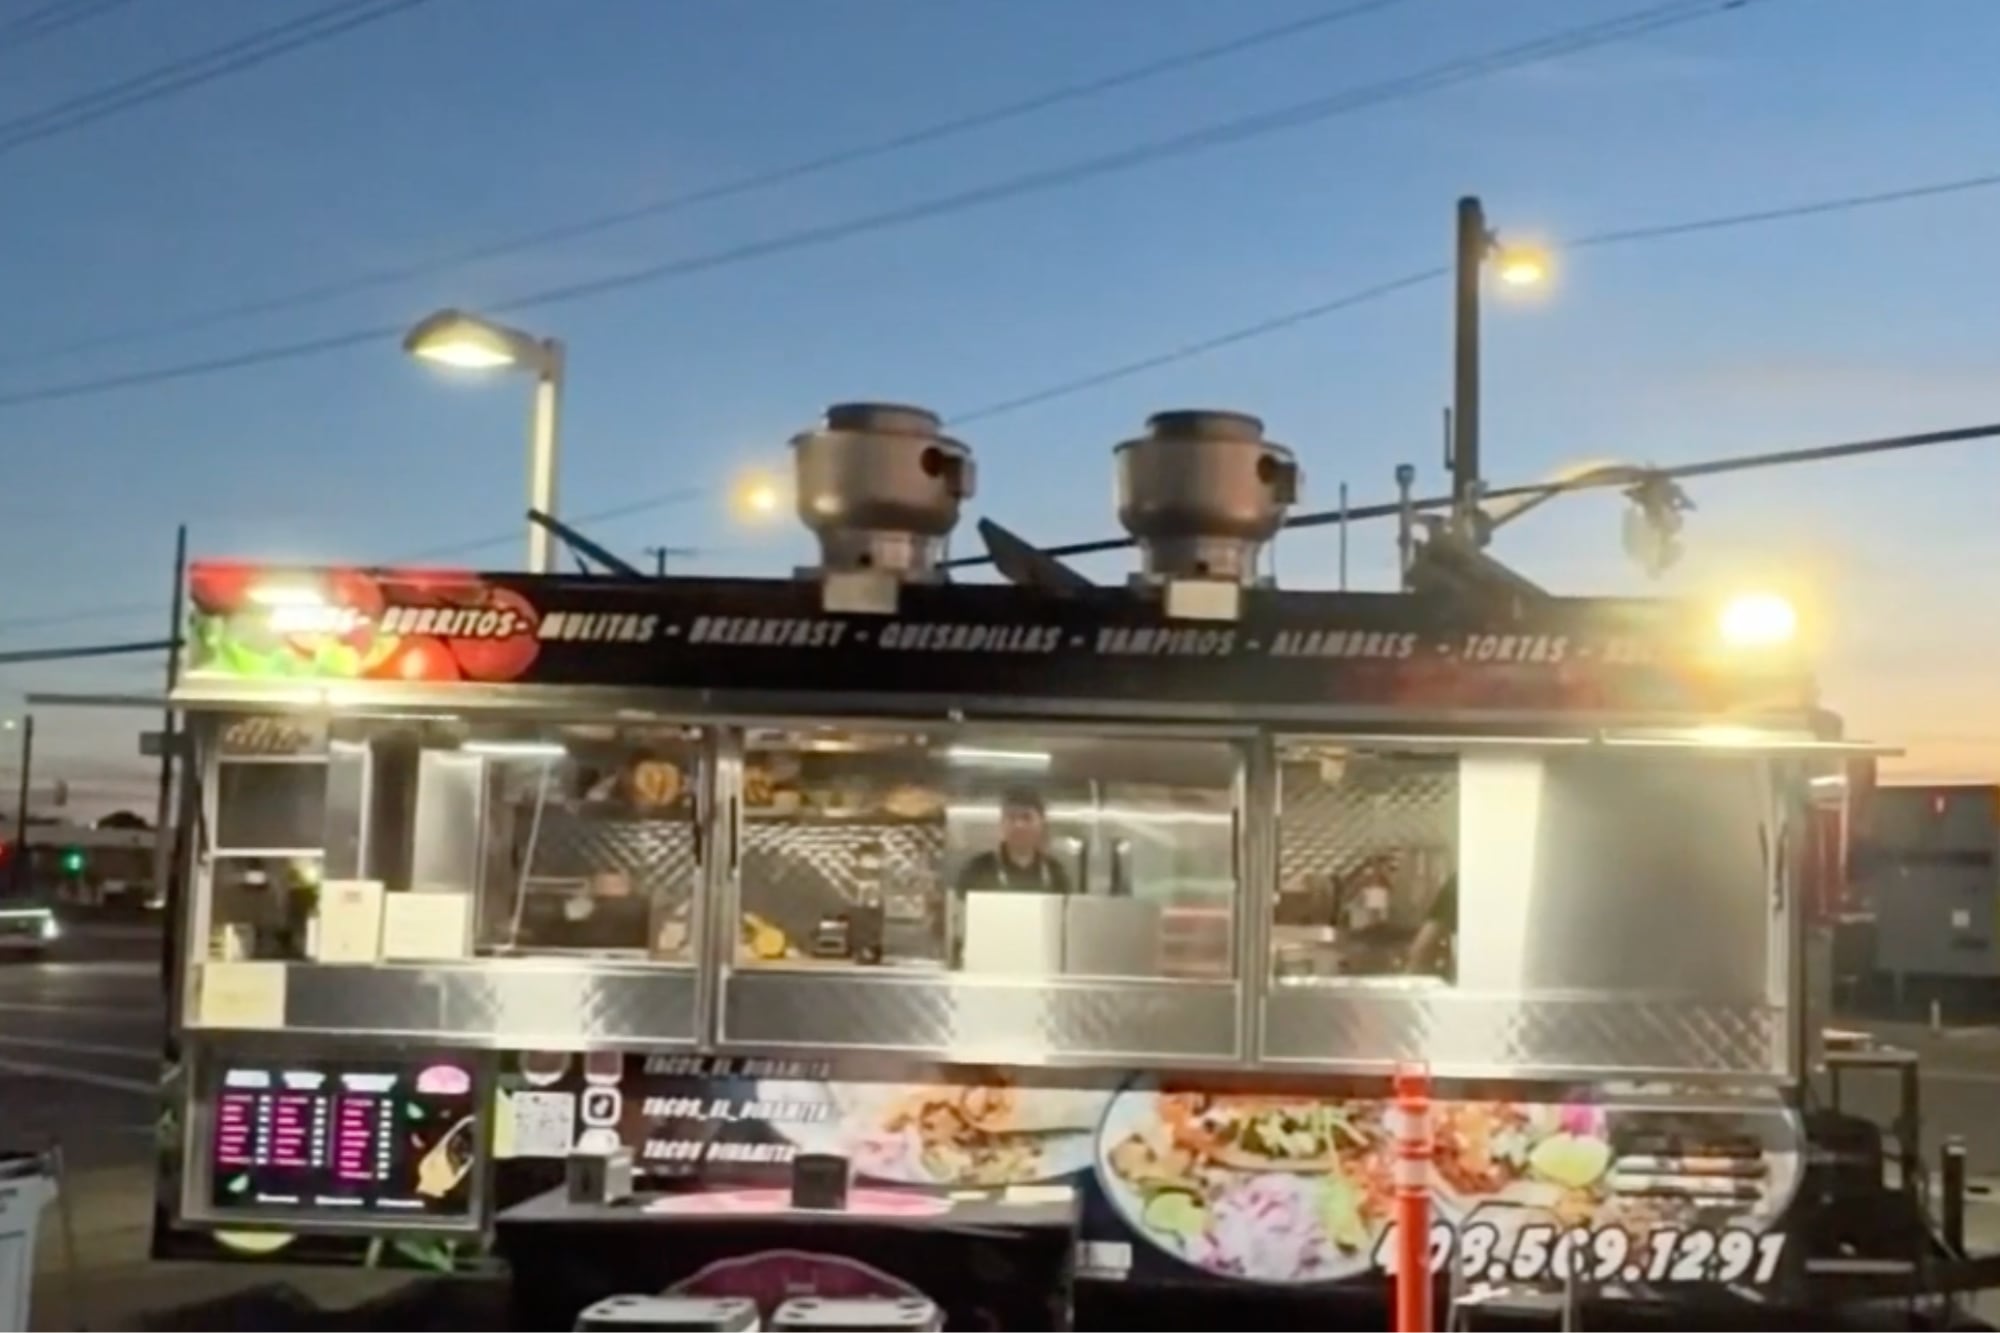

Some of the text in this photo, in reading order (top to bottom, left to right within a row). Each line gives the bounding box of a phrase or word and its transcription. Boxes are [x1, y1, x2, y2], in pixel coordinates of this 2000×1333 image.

[537, 611, 658, 641] MULITAS
[688, 615, 847, 647] BREAKFAST
[879, 621, 1063, 655] QUESADILLAS
[1095, 626, 1237, 657] VAMPIROS
[1270, 629, 1418, 659] ALAMBRES
[1463, 632, 1570, 662] TORTAS
